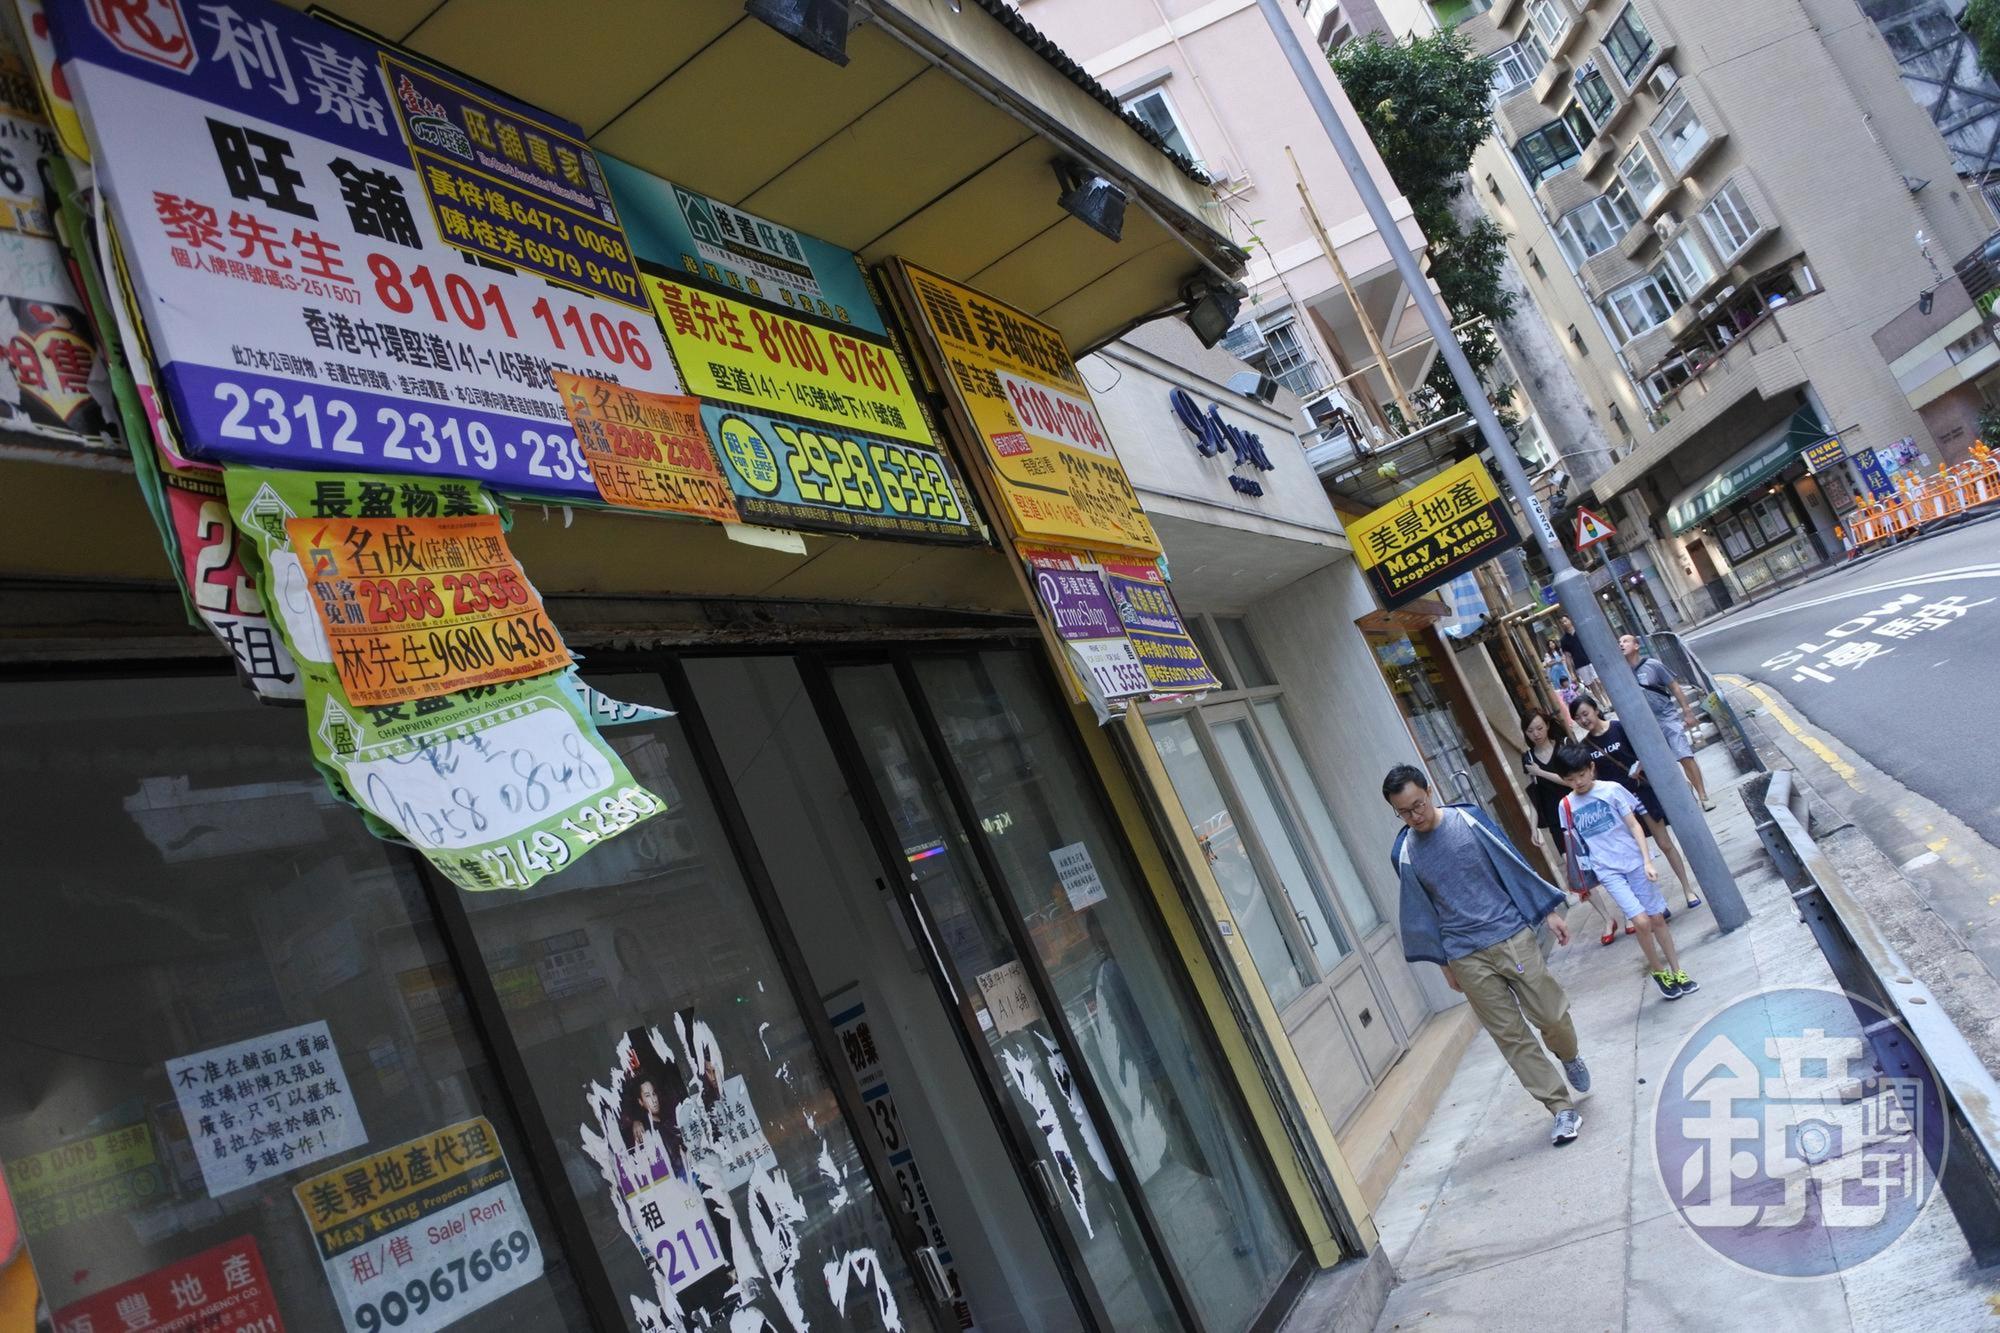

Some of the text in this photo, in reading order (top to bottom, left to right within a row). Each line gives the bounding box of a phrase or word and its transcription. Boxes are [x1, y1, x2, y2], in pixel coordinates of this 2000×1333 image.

[199, 4, 410, 146] 利嘉
[460, 105, 587, 188] 旺舖專家
[205, 116, 424, 250] 旺舖
[440, 205, 583, 278] 陳桂芳6979
[586, 260, 638, 298] 9107
[575, 224, 628, 263] 0068
[712, 204, 804, 262] 港置旺舖
[152, 190, 354, 286] 黎先生
[367, 253, 518, 339] 8101
[532, 296, 653, 372] 1106
[656, 280, 754, 354] 黃先生
[749, 308, 829, 377] 8100
[828, 334, 901, 396] 6761
[967, 299, 1082, 387] 美聯旺舖
[214, 381, 365, 455] 2312
[606, 423, 663, 464] 2366
[660, 433, 713, 473] 2336
[310, 480, 481, 518] 長盈物業
[771, 423, 883, 510] 2928
[868, 442, 961, 521] 6333
[343, 524, 507, 577] 名成(店舖)代理
[1367, 478, 1484, 560] 美景地產
[1384, 510, 1495, 578] May King
[1392, 525, 1499, 589] Property Agency
[313, 579, 358, 602] 租客
[359, 576, 445, 625] 2366
[441, 567, 529, 616] 2336
[322, 600, 366, 626] 免佣
[1038, 572, 1110, 634] PrimeShop
[212, 619, 297, 685] 租
[337, 627, 495, 690] 林先生9680
[491, 612, 556, 664] 6436
[1760, 592, 1925, 672] SLOW
[1791, 594, 1998, 684] 慢駛
[1112, 663, 1148, 692] 3555
[377, 691, 523, 740] CHAMPWIN Property Agency
[1607, 742, 1621, 754] CAP
[308, 1124, 495, 1225] 美景地產代理
[322, 1167, 508, 1253] May King Property Agency
[350, 1236, 415, 1286] 租/售
[468, 1200, 508, 1227] Rent
[639, 1200, 666, 1233] 租
[354, 1229, 532, 1333] 90967669
[656, 1218, 719, 1287] 211
[199, 1293, 242, 1318] AGENCY
